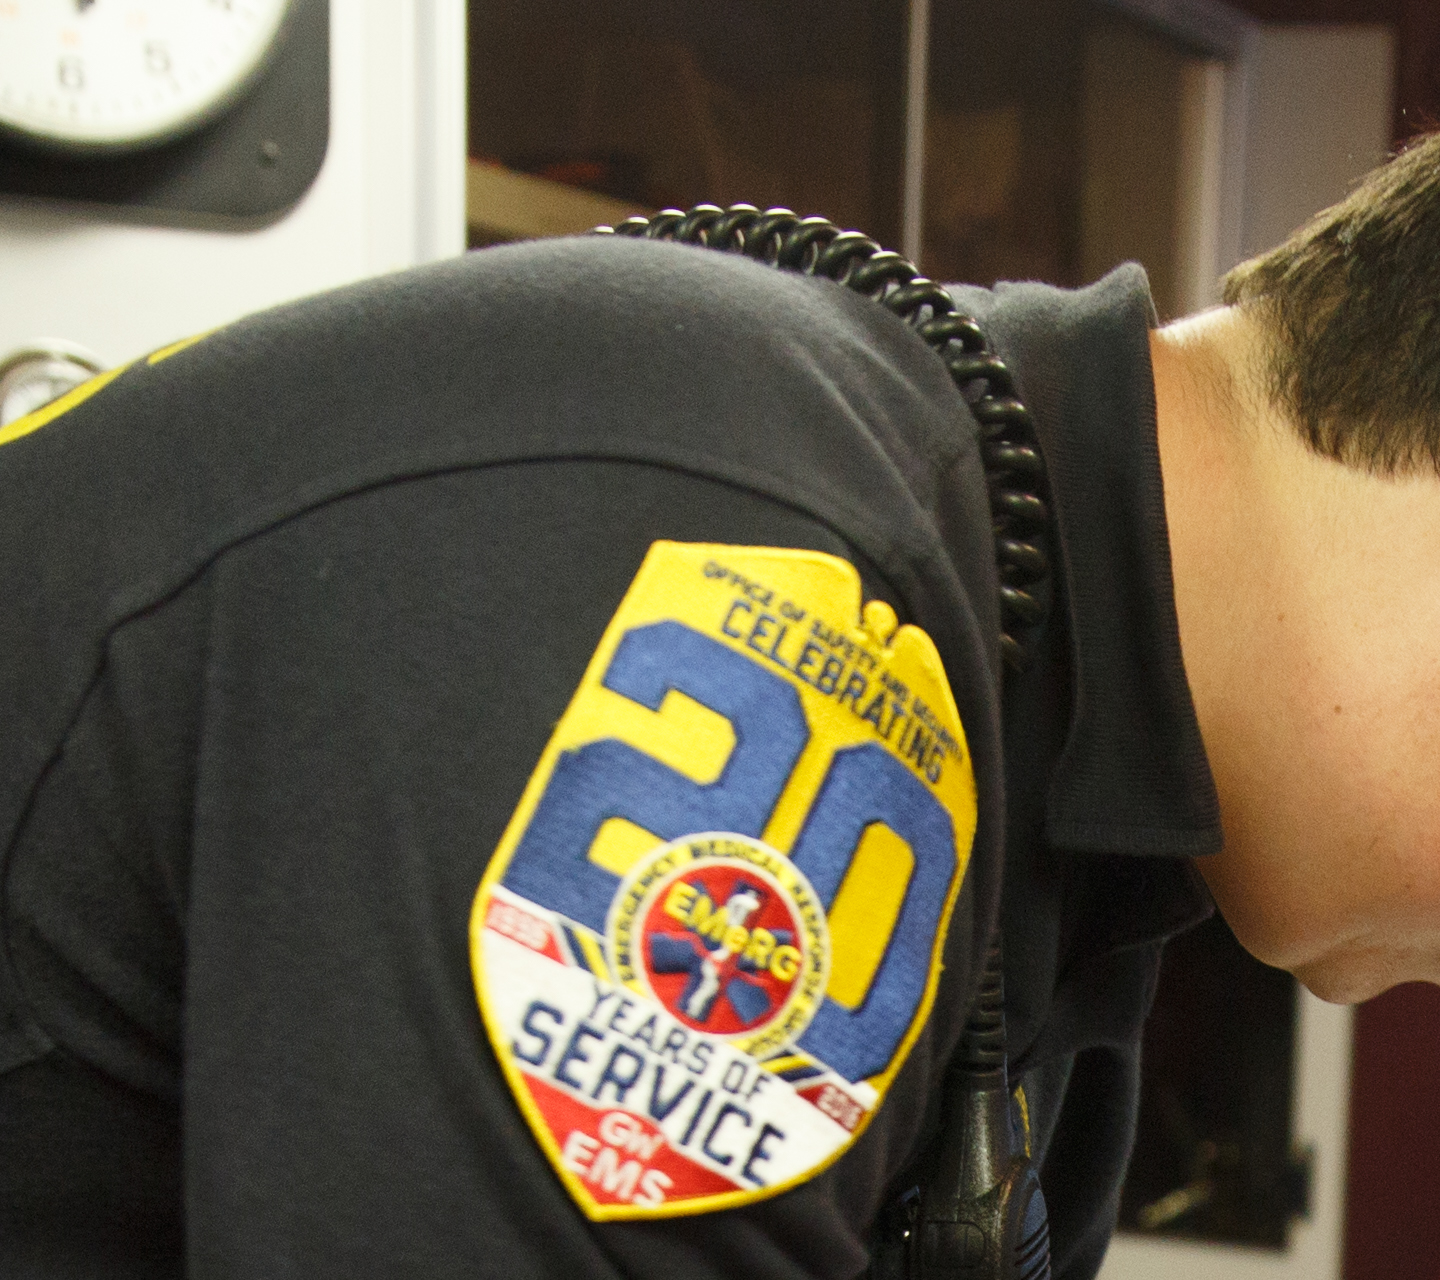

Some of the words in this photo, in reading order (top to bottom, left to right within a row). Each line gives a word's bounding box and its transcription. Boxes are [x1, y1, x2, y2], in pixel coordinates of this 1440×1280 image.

[58, 54, 87, 91] 6
[702, 560, 775, 607] OFFICE
[779, 600, 806, 622] OF
[721, 599, 946, 785] CELEBRATING
[504, 618, 957, 1084] 20
[512, 999, 786, 1188] SERVICE
[590, 988, 715, 1075] YEARS
[722, 1060, 771, 1100] OF
[562, 1130, 674, 1209] EMS
